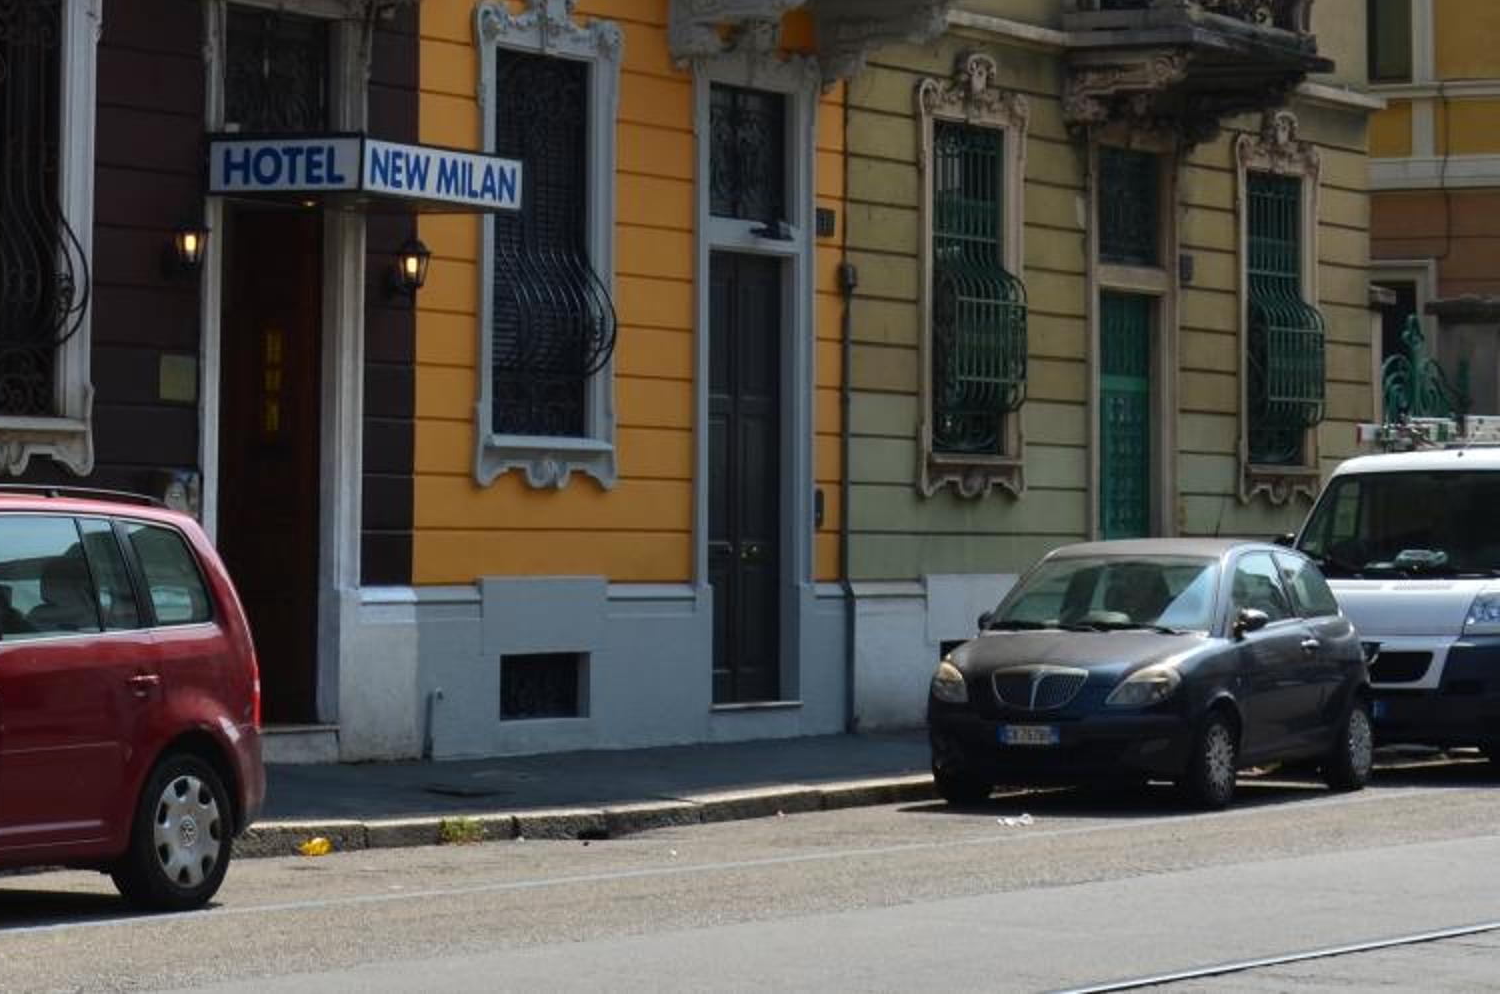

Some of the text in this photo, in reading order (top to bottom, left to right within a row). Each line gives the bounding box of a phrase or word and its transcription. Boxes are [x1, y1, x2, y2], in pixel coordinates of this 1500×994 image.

[222, 145, 345, 185] HOTEL
[370, 147, 517, 203] NEW MILAN
